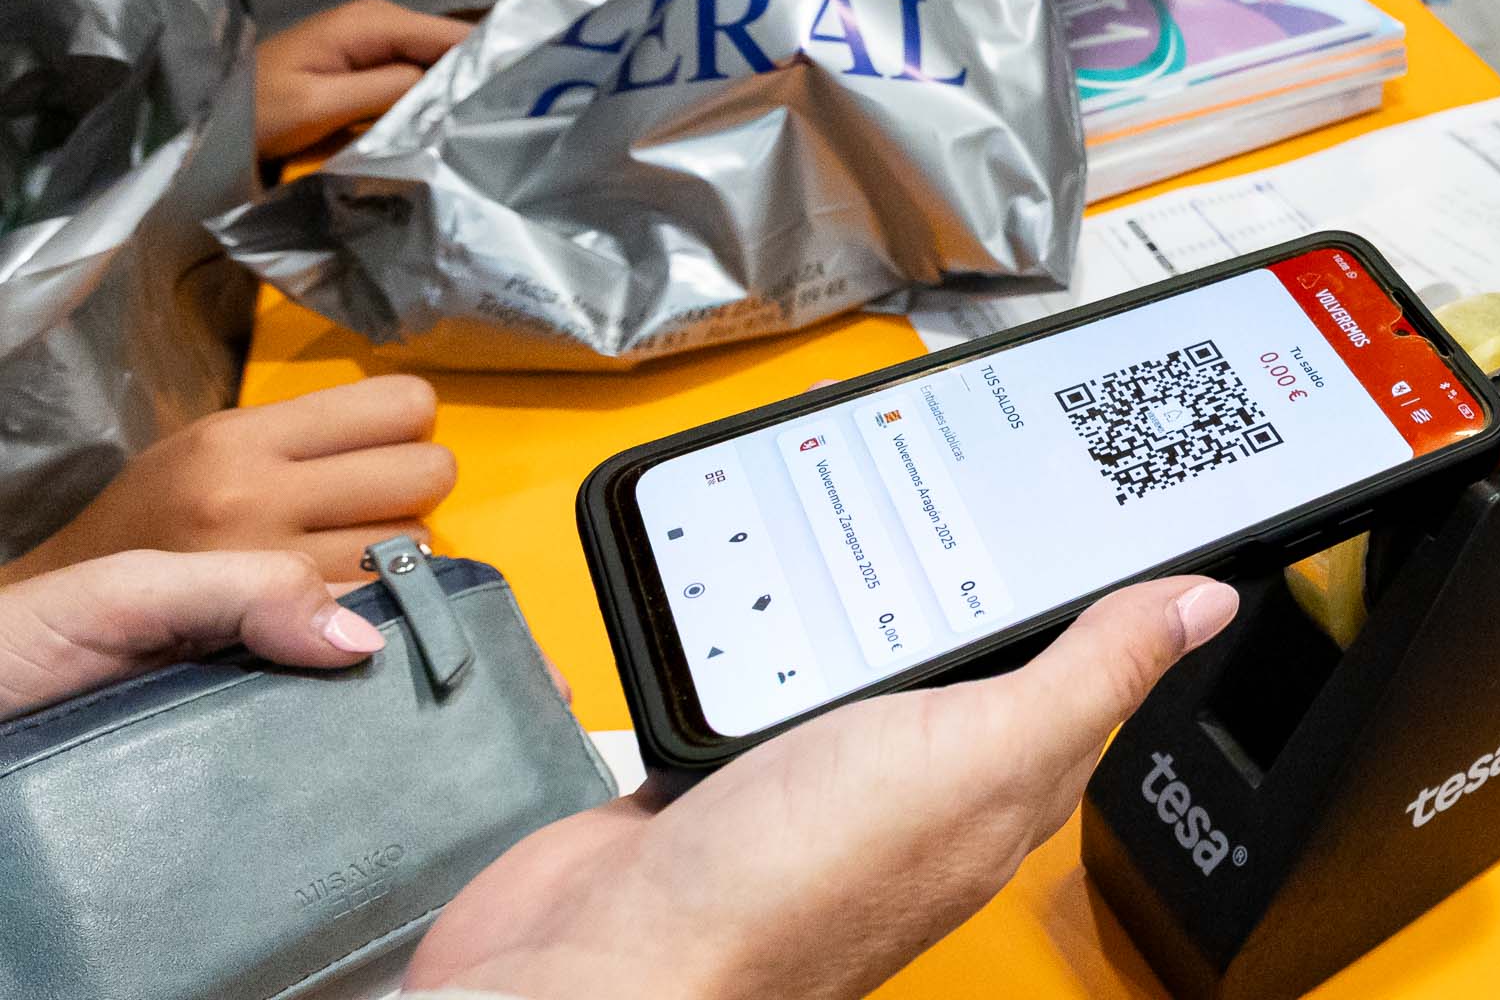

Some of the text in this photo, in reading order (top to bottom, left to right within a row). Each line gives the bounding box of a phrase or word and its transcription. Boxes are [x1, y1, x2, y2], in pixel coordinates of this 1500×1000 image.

[1315, 289, 1370, 348] VOLVEREMOS
[980, 365, 1024, 430] TUS SALDOS
[1260, 352, 1308, 403] 0,00 €
[1289, 346, 1325, 389] Tu saldo
[920, 384, 946, 426] Entidades
[892, 433, 957, 550] Volveremos Aragón 2025
[816, 459, 881, 590] Volveremos Zaragoza 2025
[294, 843, 406, 907] MISAKO
